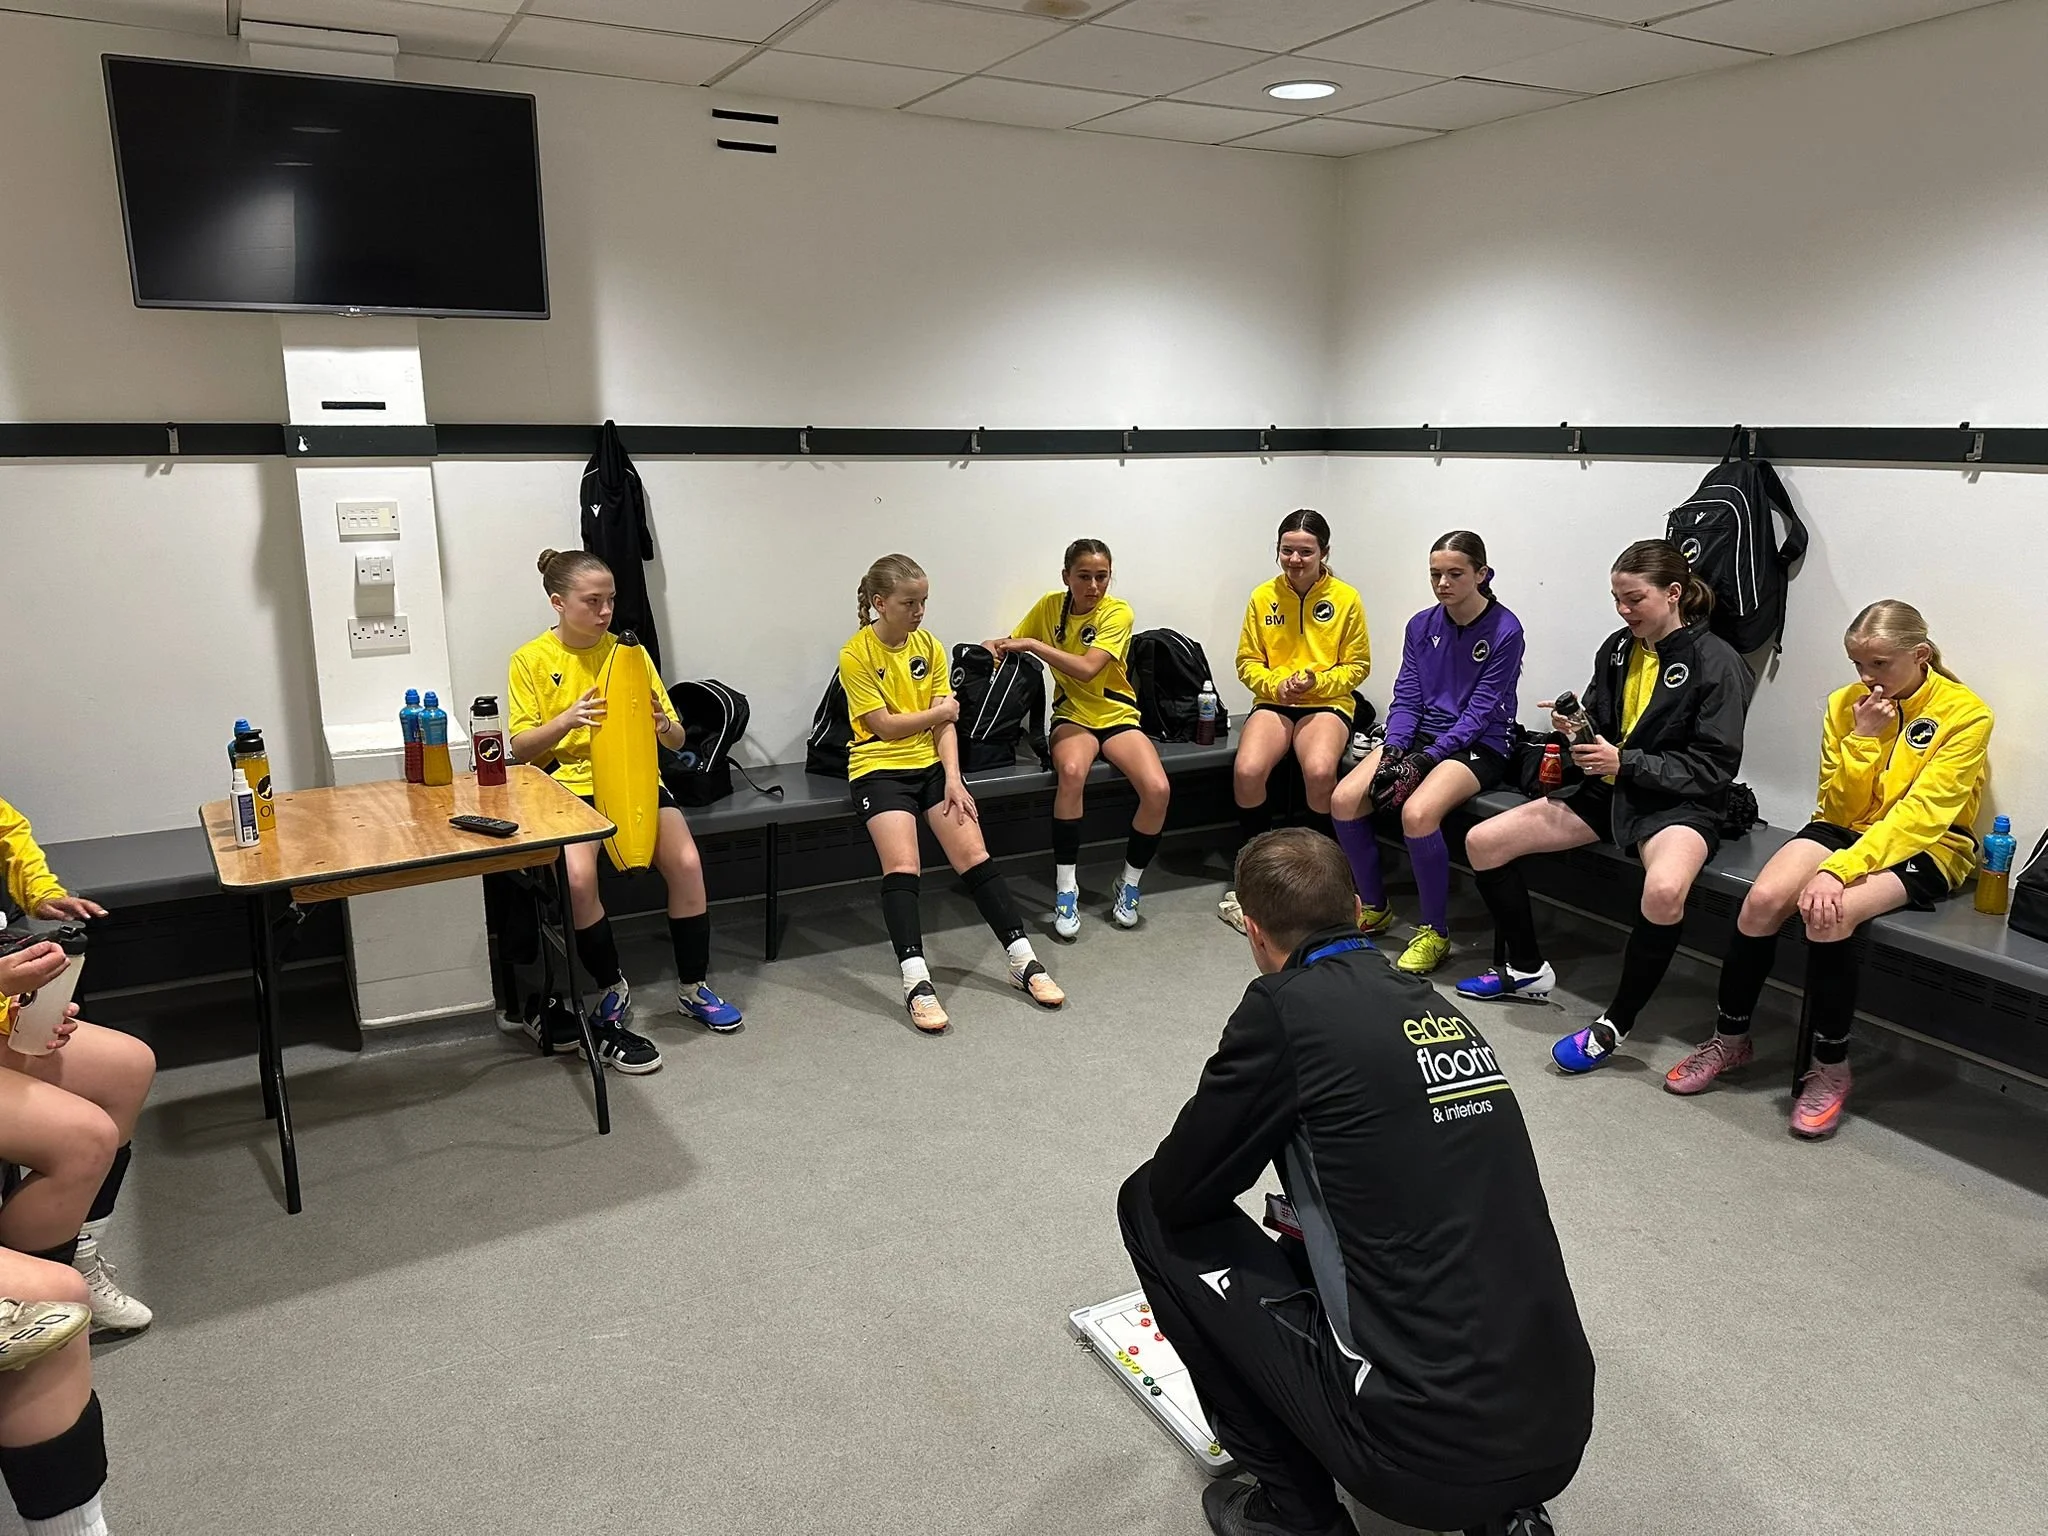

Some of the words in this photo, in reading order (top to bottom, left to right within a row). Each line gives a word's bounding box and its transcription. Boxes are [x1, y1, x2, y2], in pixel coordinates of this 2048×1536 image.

[1265, 615, 1285, 625] BM
[1610, 652, 1625, 666] RU
[862, 797, 870, 810] 5
[1403, 1010, 1476, 1045] eden
[1432, 1107, 1444, 1123] &
[1445, 1099, 1493, 1121] interiors
